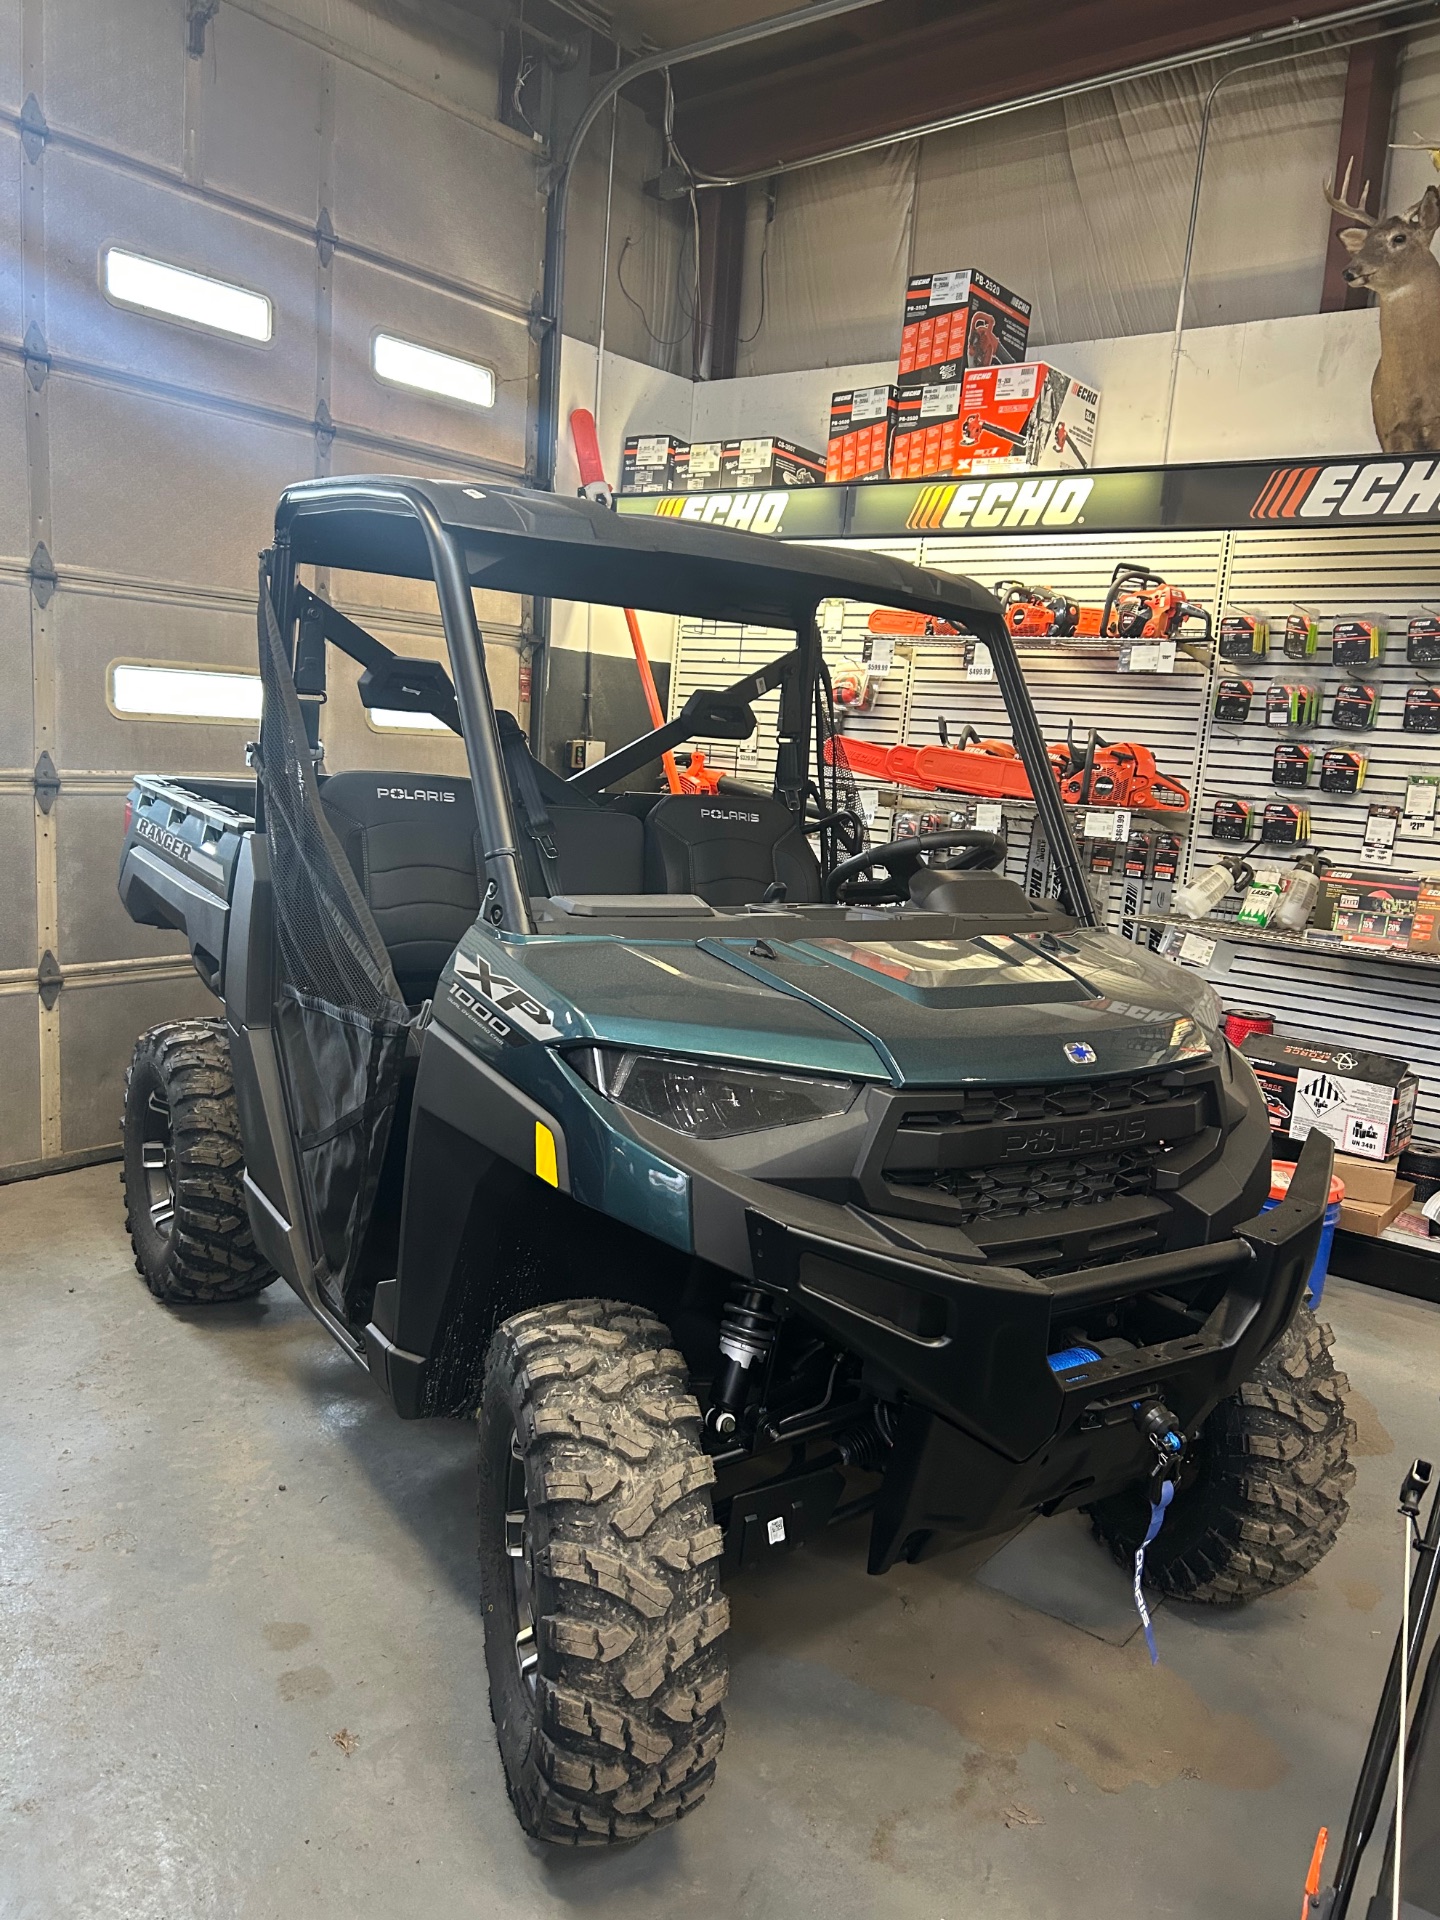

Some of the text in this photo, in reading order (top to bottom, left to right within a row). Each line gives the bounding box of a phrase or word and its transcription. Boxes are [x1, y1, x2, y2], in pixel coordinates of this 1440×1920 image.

[914, 278, 931, 286] ECHO
[975, 272, 1001, 296] PB-2520
[1013, 297, 1031, 314] ECHO
[972, 372, 992, 380] ECHO
[1076, 384, 1098, 405] ECHO
[1300, 460, 1440, 518] ECH
[681, 492, 790, 534] ECHO
[943, 478, 1095, 529] ECHO
[968, 668, 991, 676] $499.99
[376, 786, 456, 803] POLARIS
[701, 808, 760, 823] POLARIS
[1115, 814, 1125, 841] $469.99
[136, 817, 192, 861] RANGER
[1030, 868, 1043, 898] CHO
[1331, 871, 1353, 879] ECHO
[1251, 889, 1273, 897] LASER
[1387, 923, 1400, 932] 20%
[454, 953, 553, 1026] XP
[449, 982, 511, 1036] 1000
[447, 997, 504, 1045] DUAL OVERHEAD CAM
[1000, 1119, 1147, 1158] POLARIS
[1351, 1139, 1376, 1150] UN 3481
